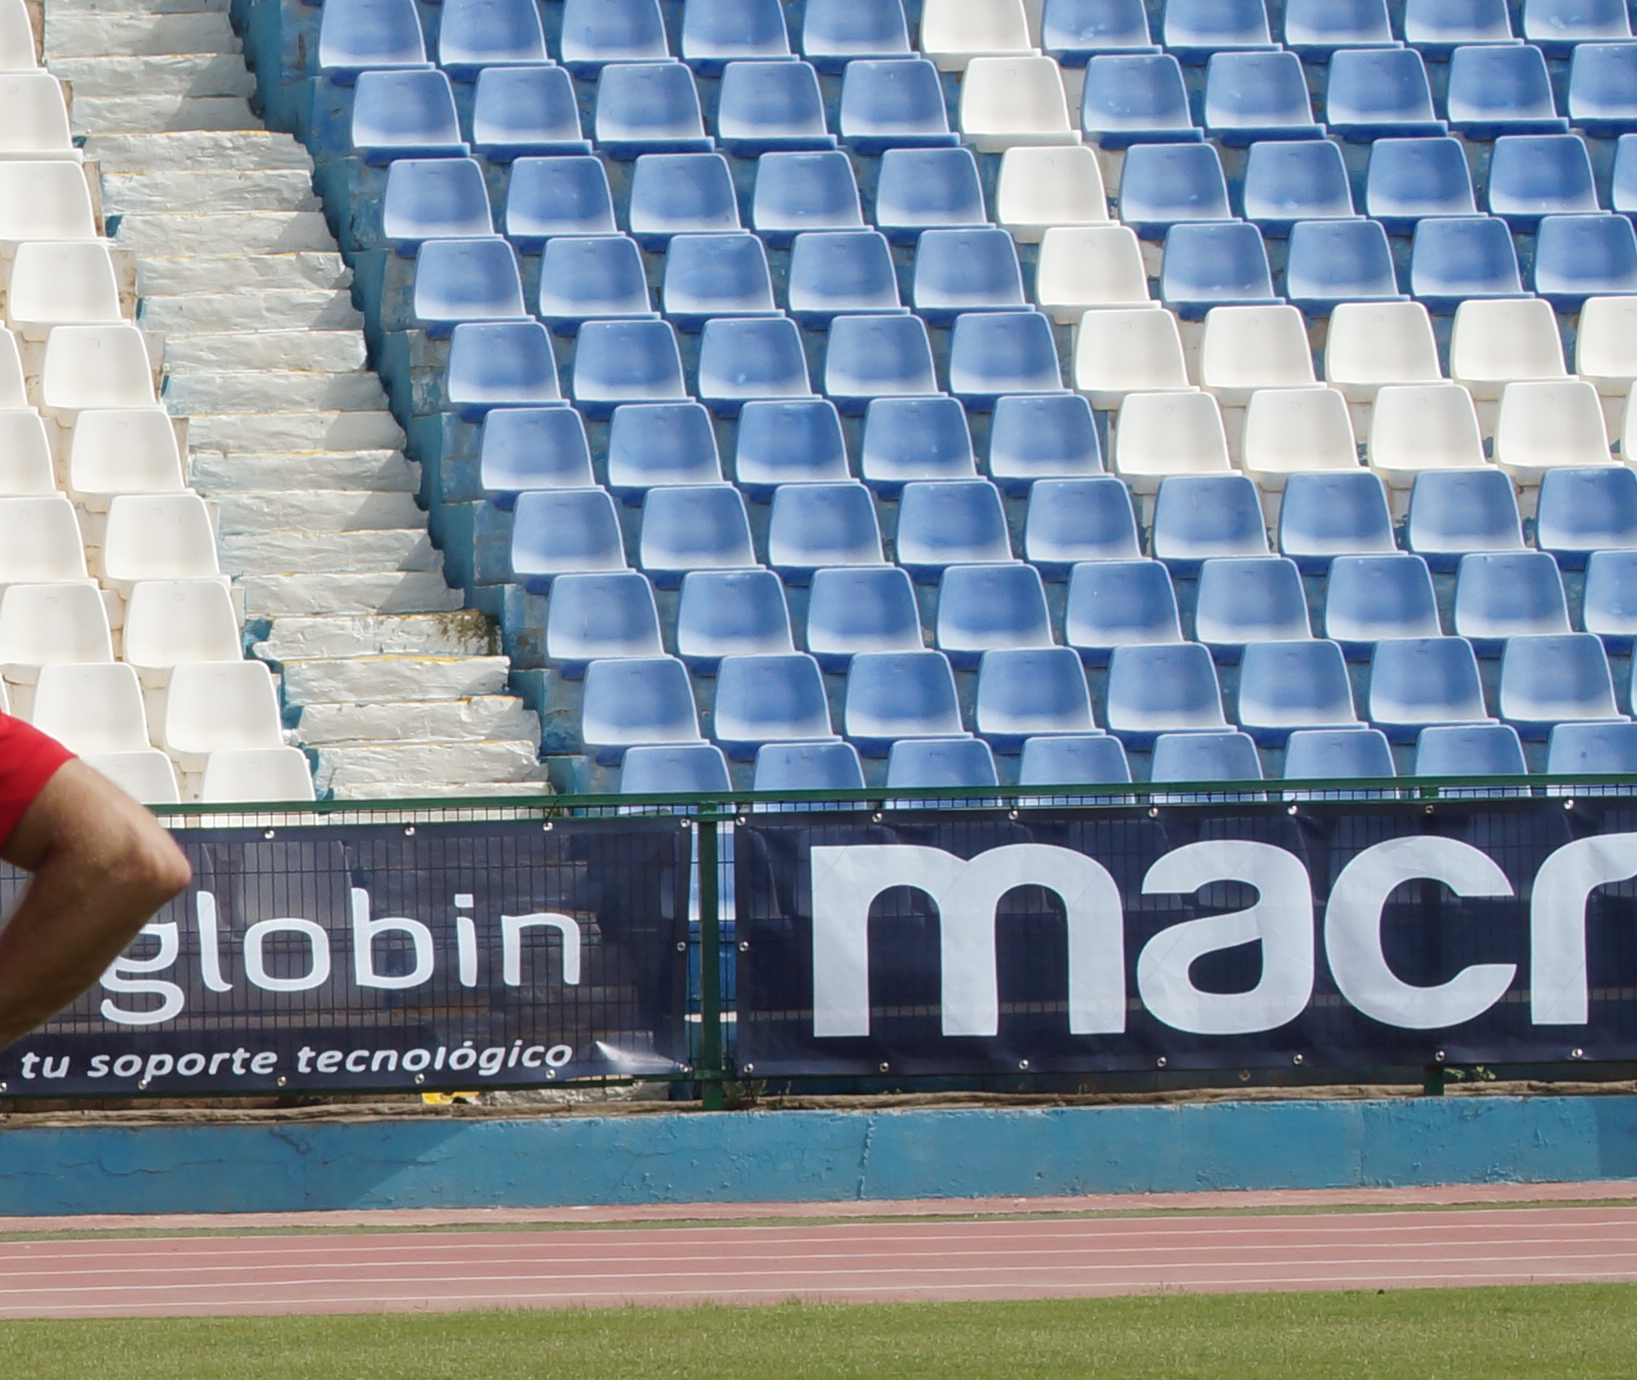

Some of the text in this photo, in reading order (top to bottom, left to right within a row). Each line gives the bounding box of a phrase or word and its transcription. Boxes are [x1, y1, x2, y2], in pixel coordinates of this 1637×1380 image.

[810, 831, 1637, 1037] macr
[21, 1038, 574, 1082] tu soporte tecnológico
